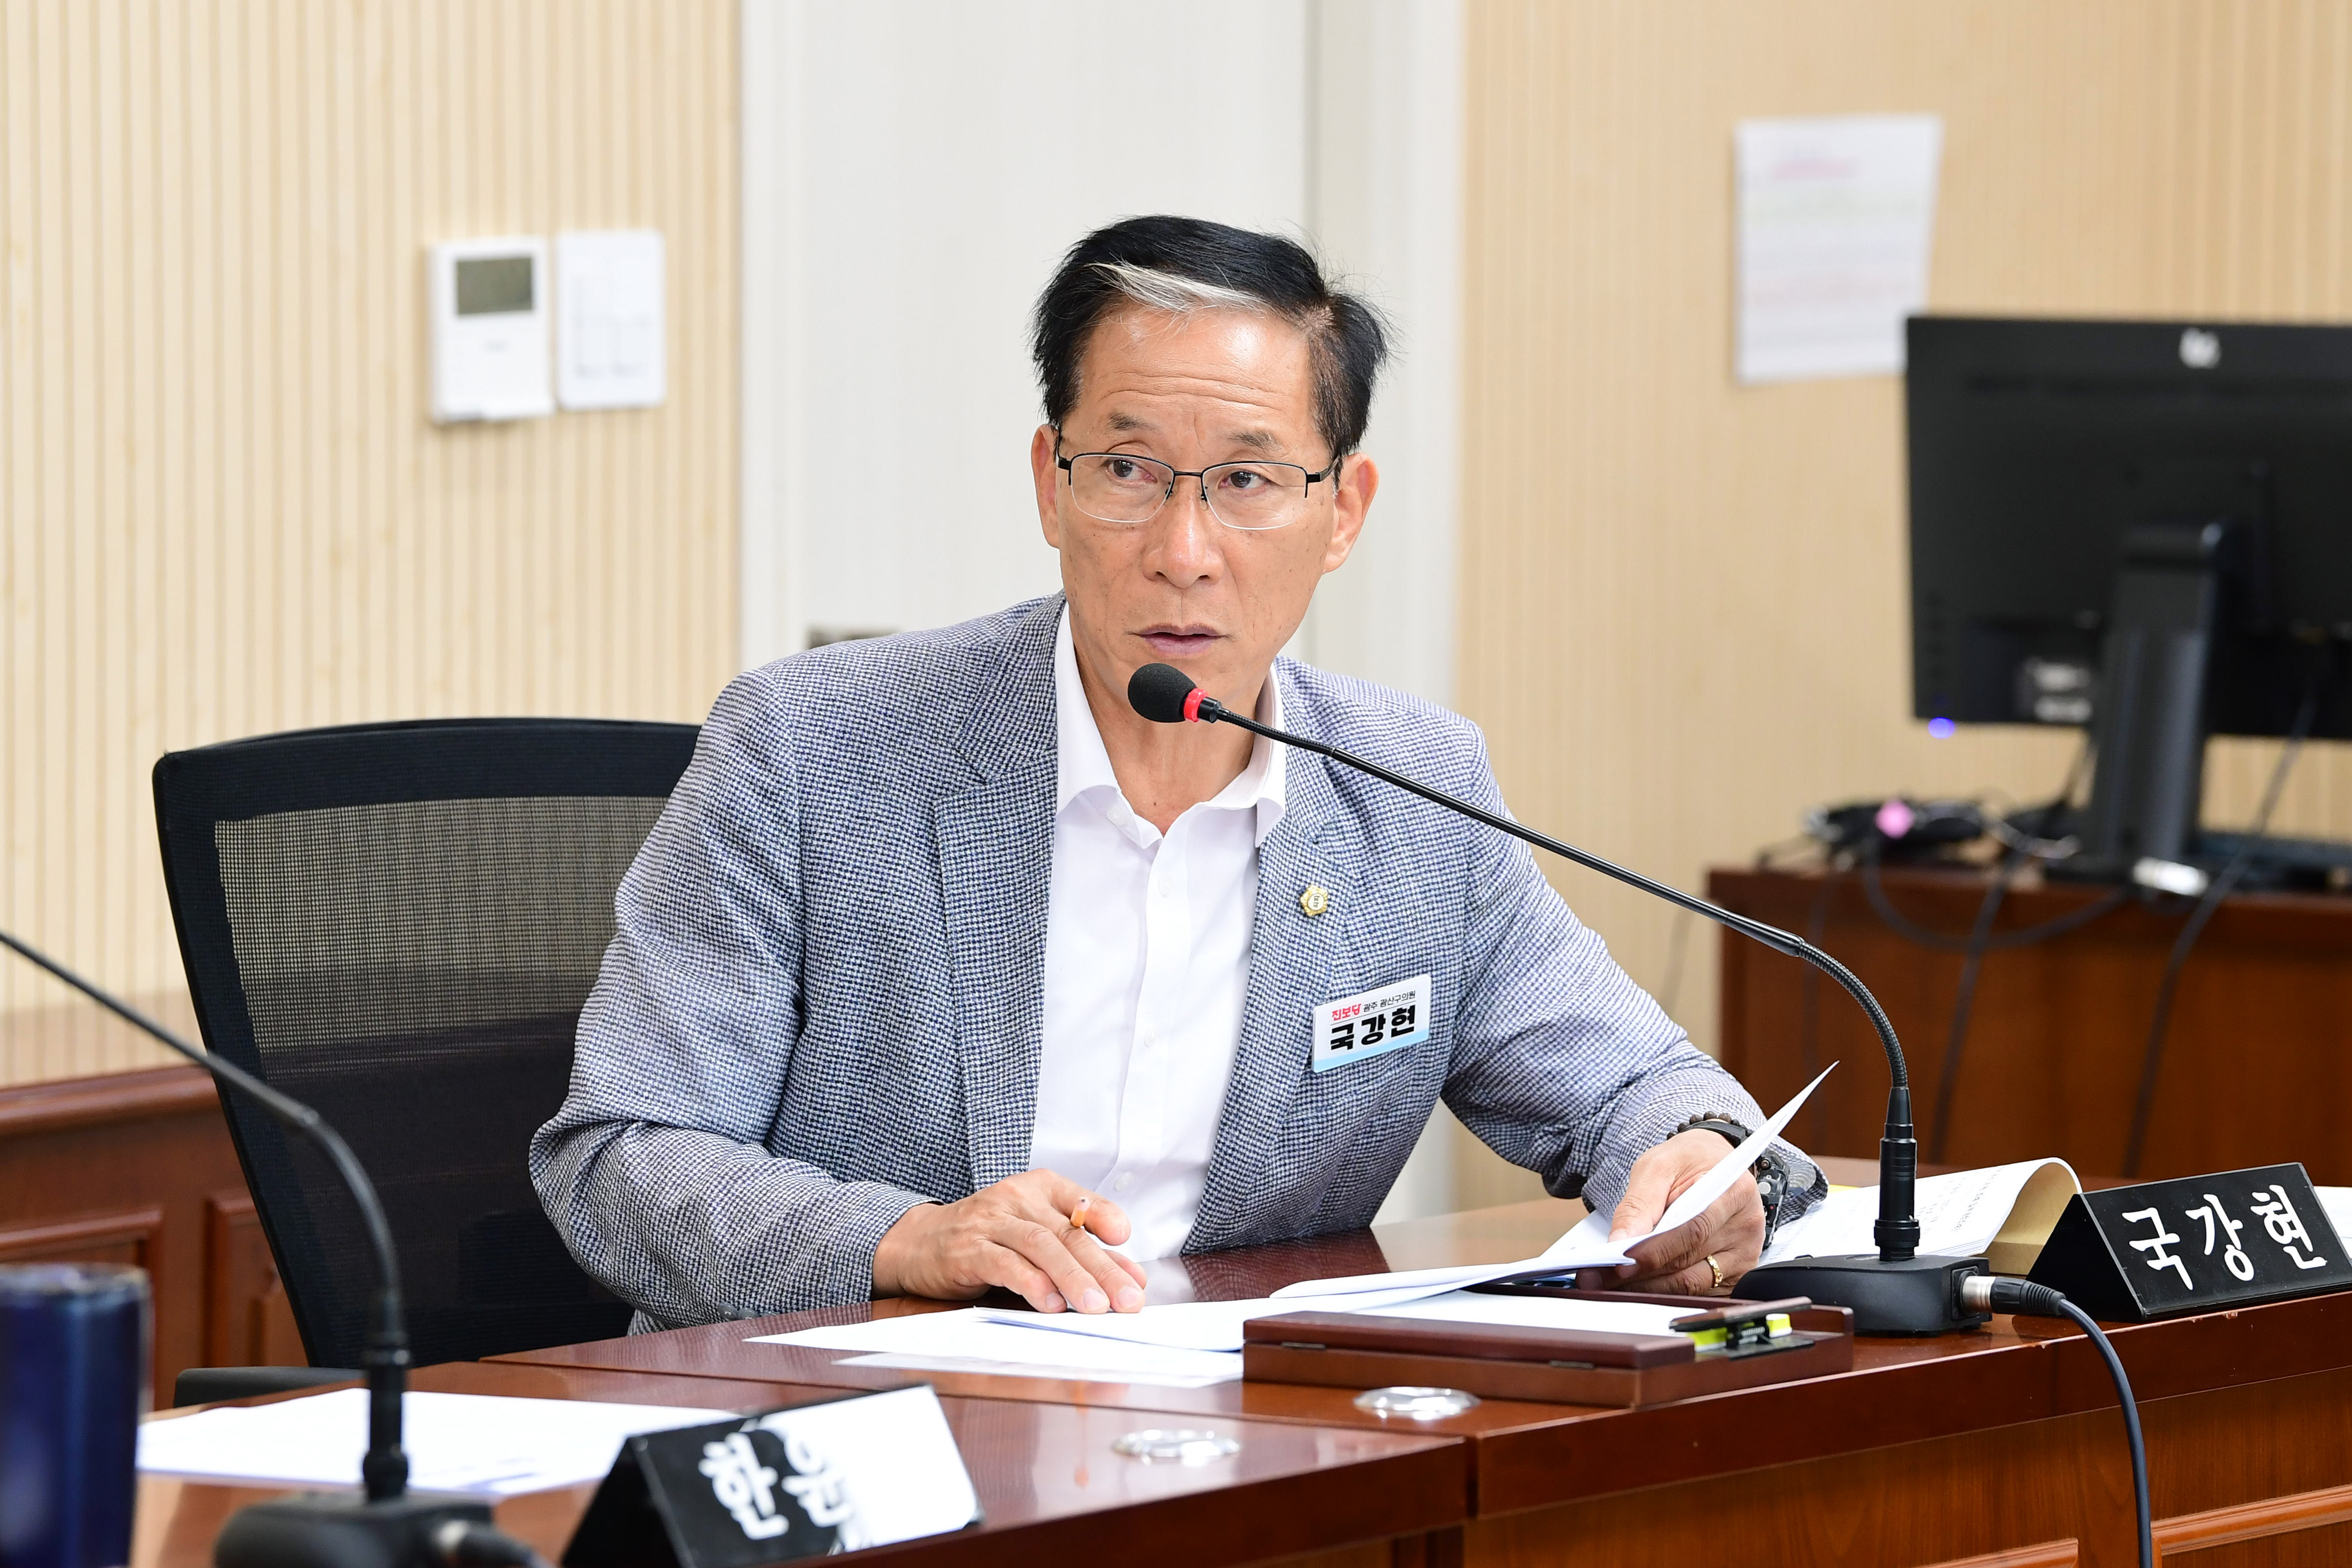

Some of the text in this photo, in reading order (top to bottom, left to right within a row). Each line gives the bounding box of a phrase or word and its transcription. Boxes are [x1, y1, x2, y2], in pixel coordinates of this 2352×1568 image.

[1330, 1004, 1416, 1051] 국강현
[1332, 990, 1416, 1021] 진보당 광주 광산구의원
[2122, 1184, 2328, 1291] 국강현
[698, 1430, 855, 1540] 한윤
